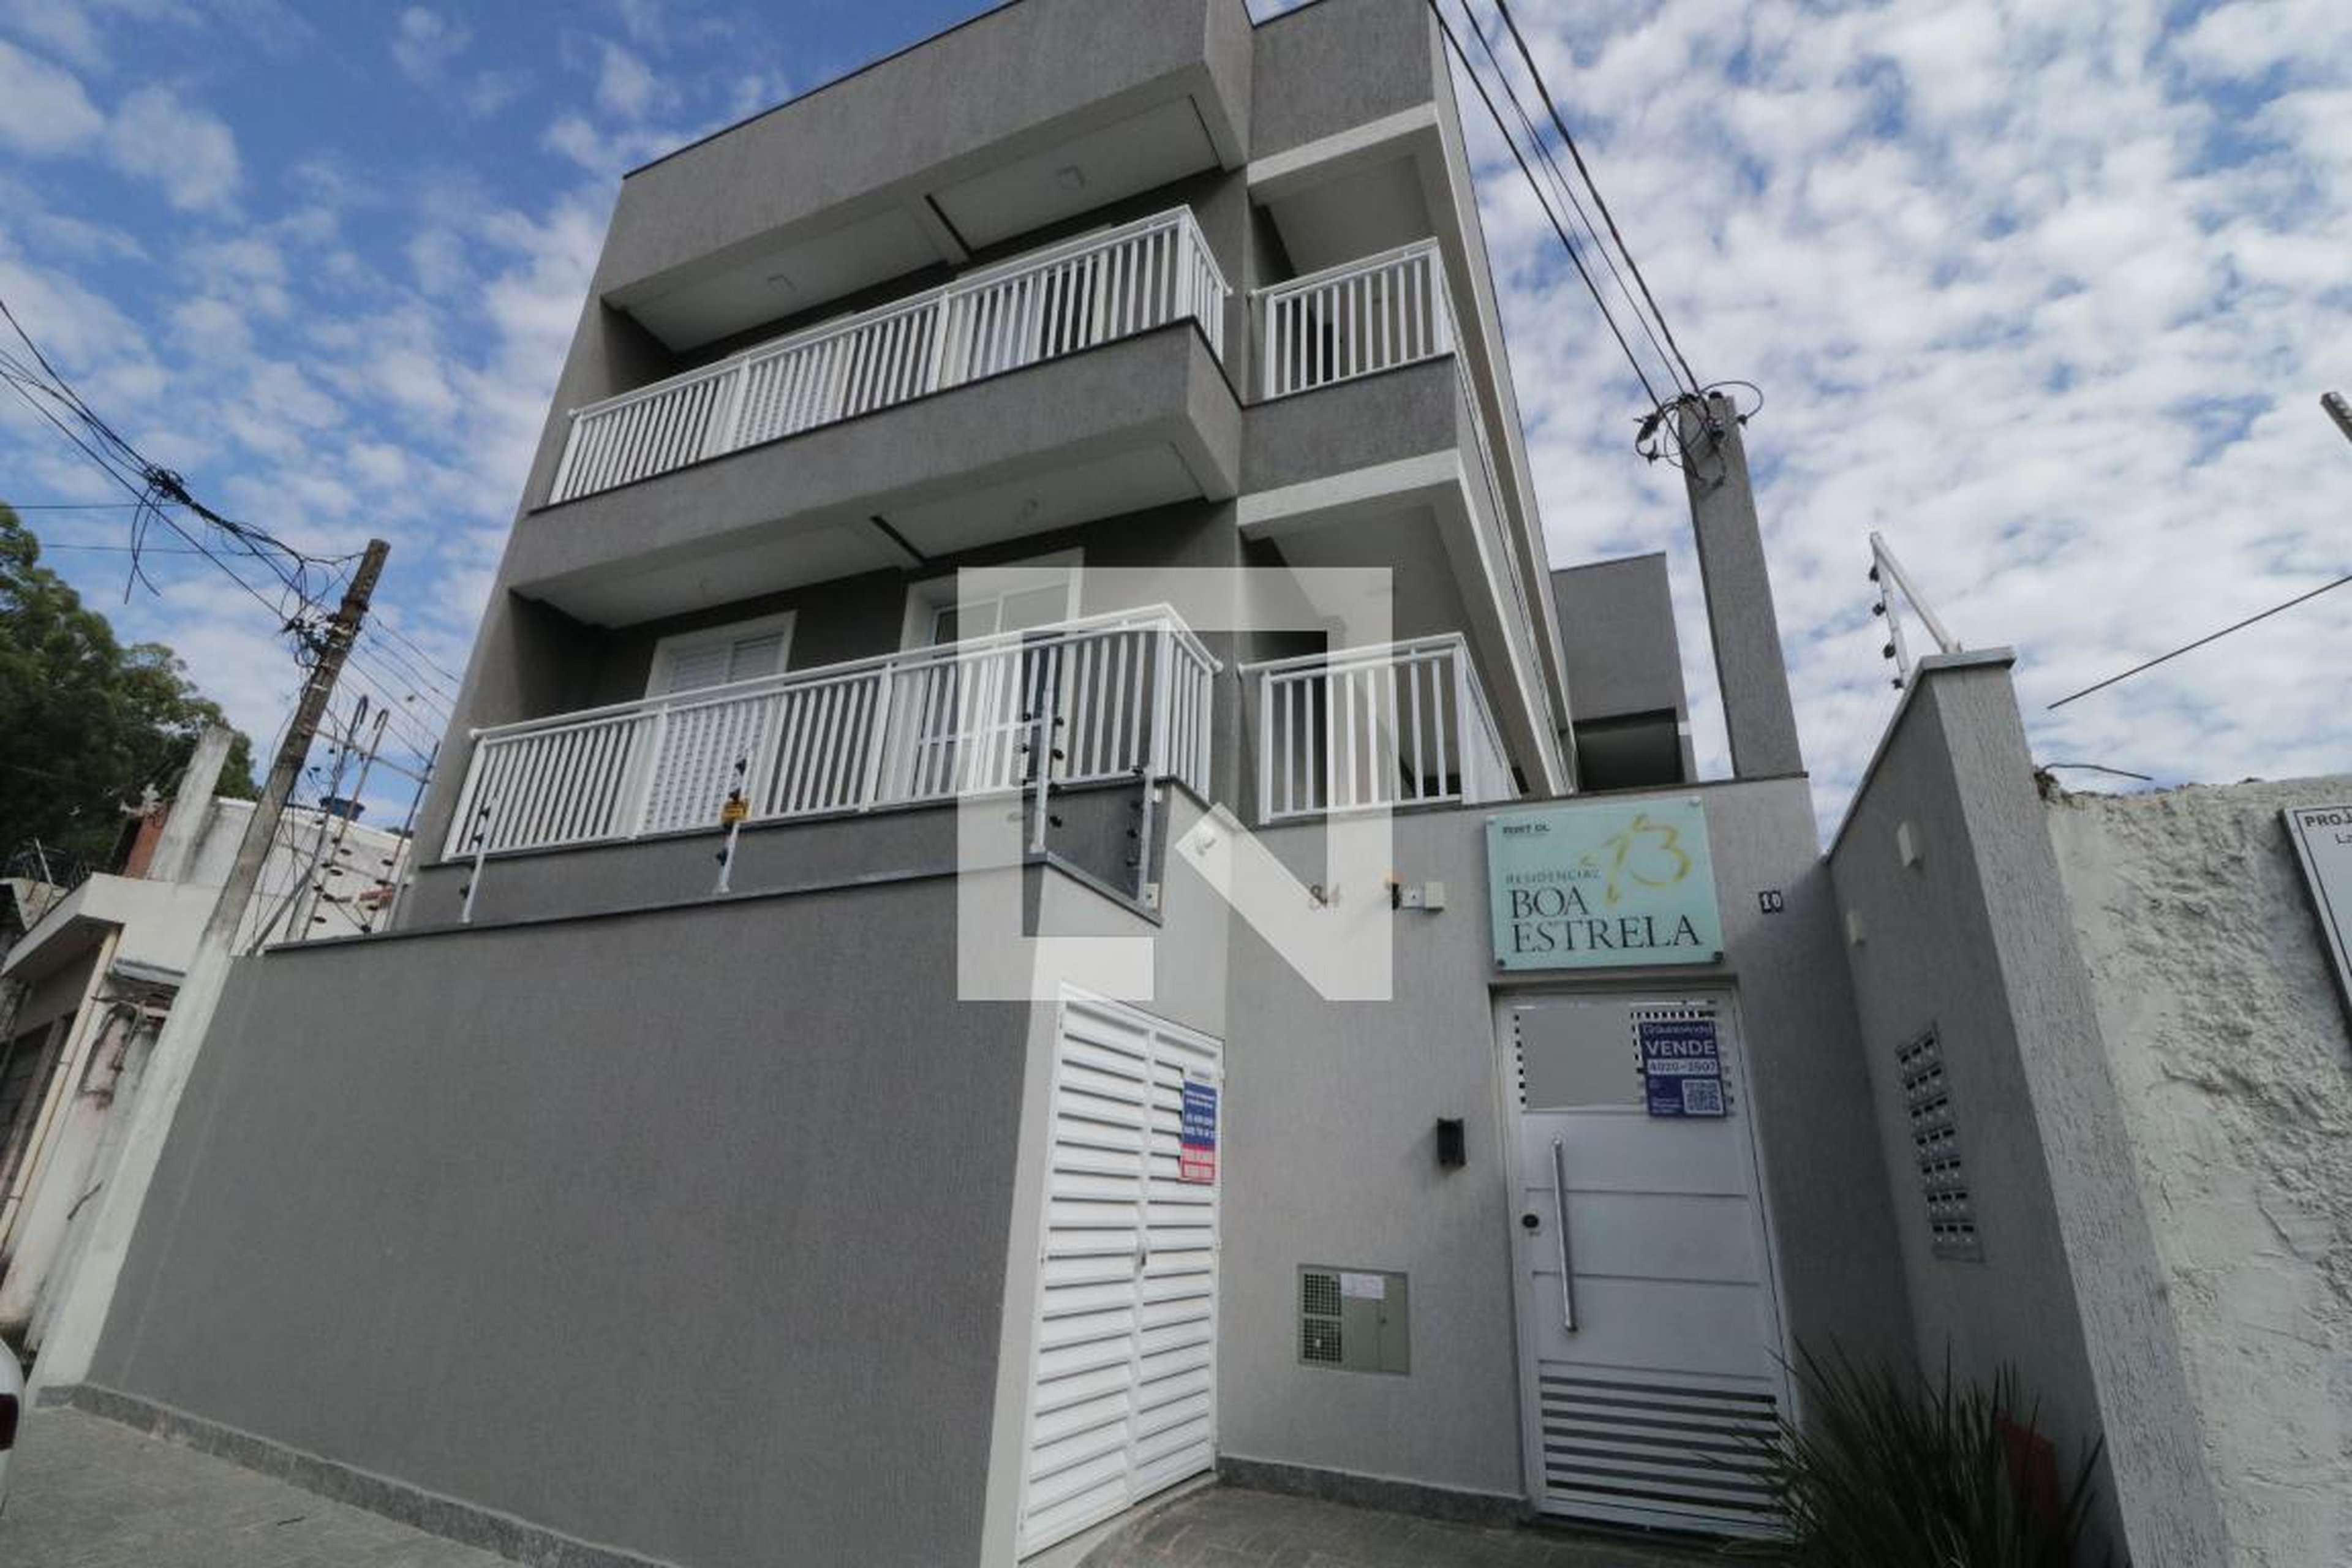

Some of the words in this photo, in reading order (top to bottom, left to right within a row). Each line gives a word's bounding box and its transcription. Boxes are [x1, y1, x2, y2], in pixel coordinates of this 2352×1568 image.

[1511, 886, 1589, 919] BOA
[1511, 914, 1703, 953] ESTRELA
[1645, 1039, 1716, 1057] VENDE
